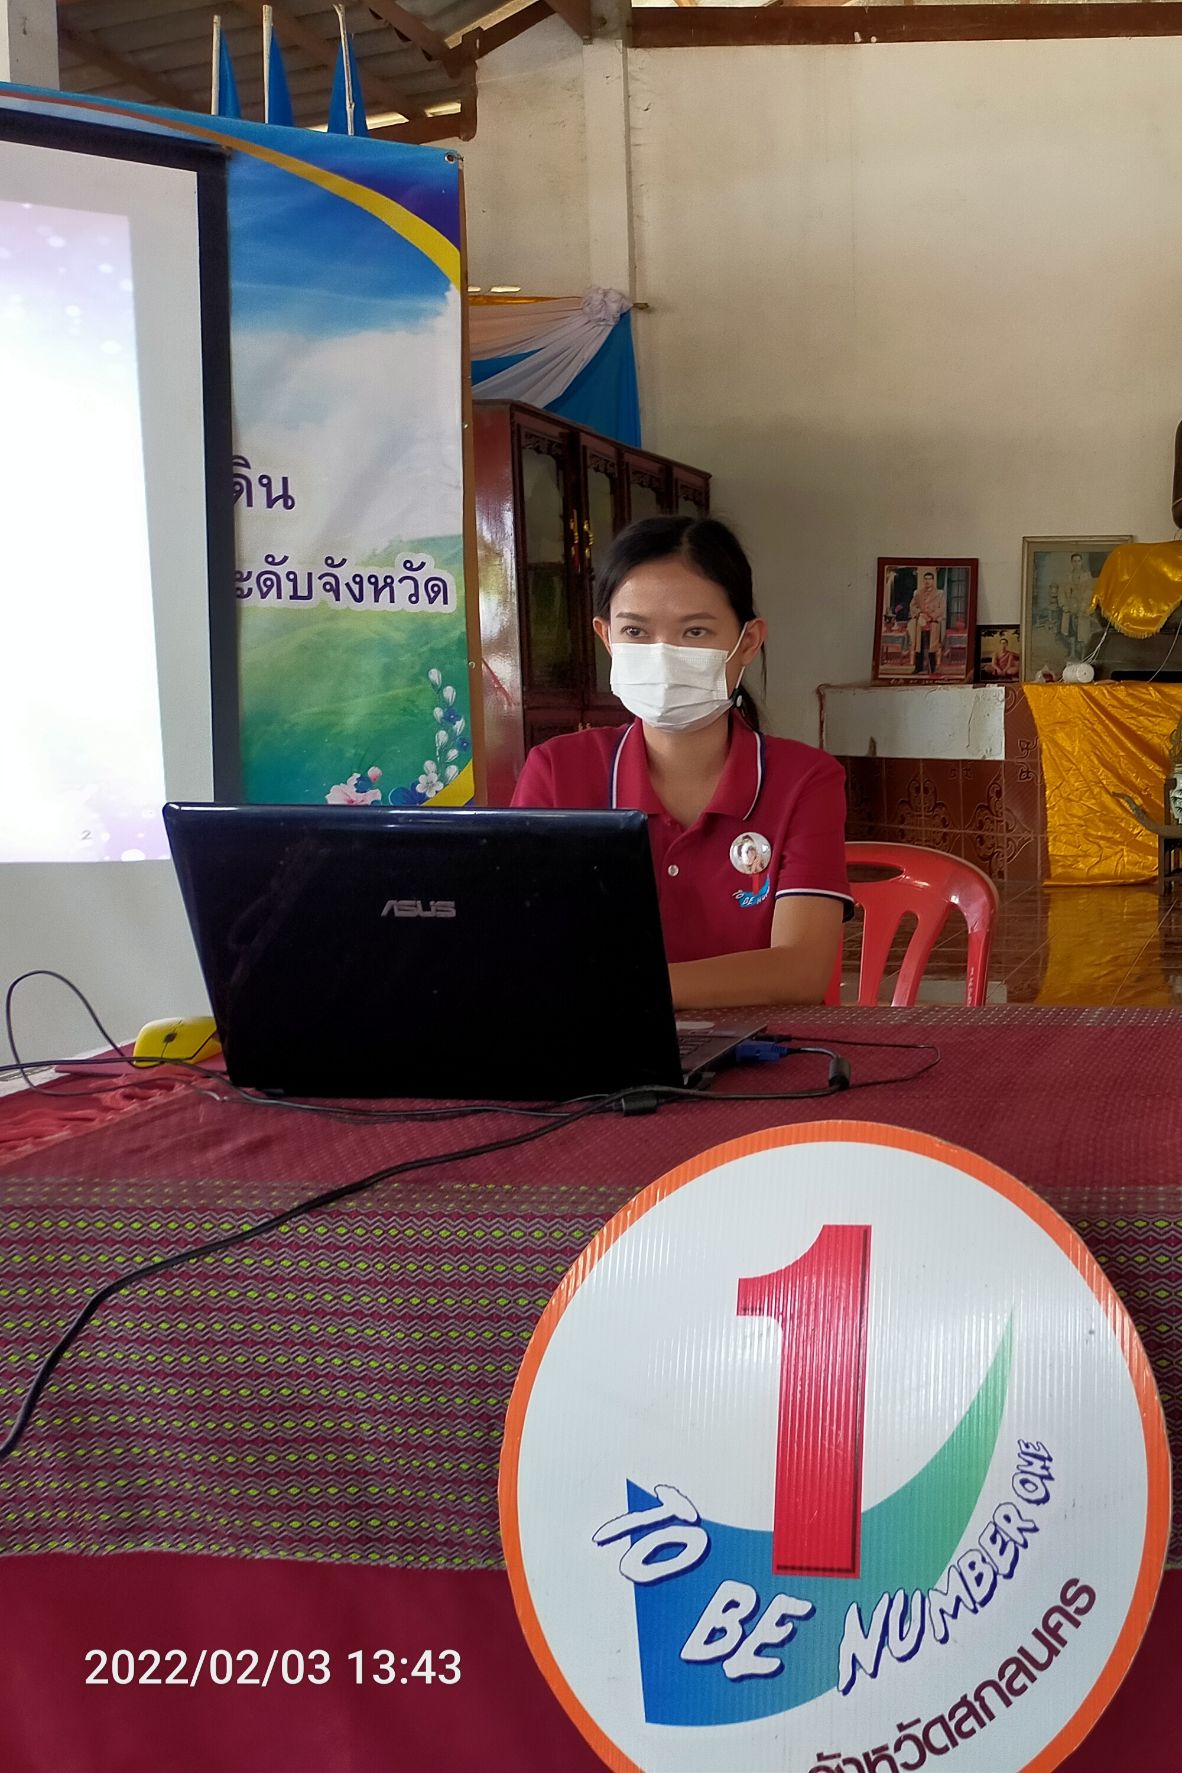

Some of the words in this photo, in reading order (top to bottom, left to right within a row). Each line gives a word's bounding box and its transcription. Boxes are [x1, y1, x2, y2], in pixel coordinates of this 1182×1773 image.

[381, 900, 457, 917] ASUS
[736, 1224, 872, 1578] 1
[592, 1484, 712, 1586] TO
[680, 1579, 816, 1682] BE
[837, 1502, 1039, 1696] NUMBER
[1012, 1439, 1055, 1506] ONE
